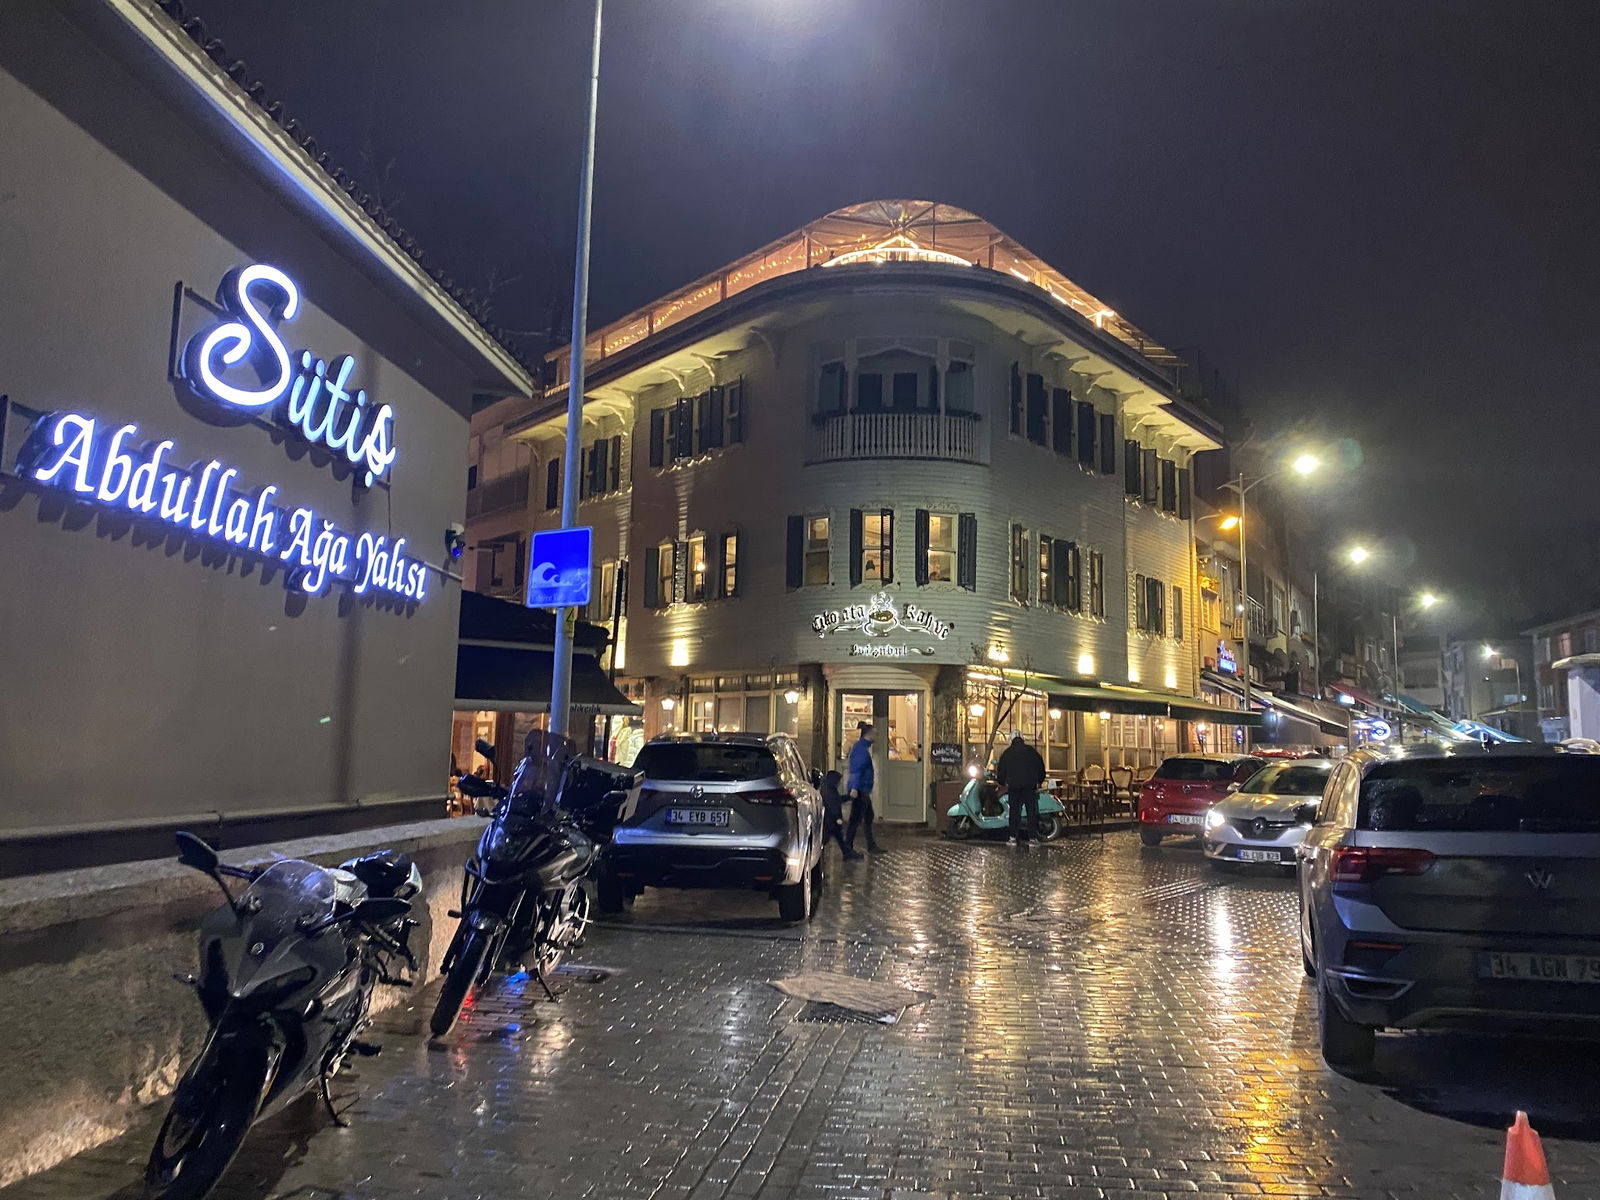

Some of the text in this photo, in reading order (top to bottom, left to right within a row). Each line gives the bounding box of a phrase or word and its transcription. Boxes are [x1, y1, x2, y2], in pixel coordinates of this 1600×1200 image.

[200, 264, 396, 488] Sütiş
[35, 413, 427, 600] Abdullah Ağa Yalısı
[672, 811, 727, 823] 34 EYB 651
[1491, 953, 1518, 976] 34
